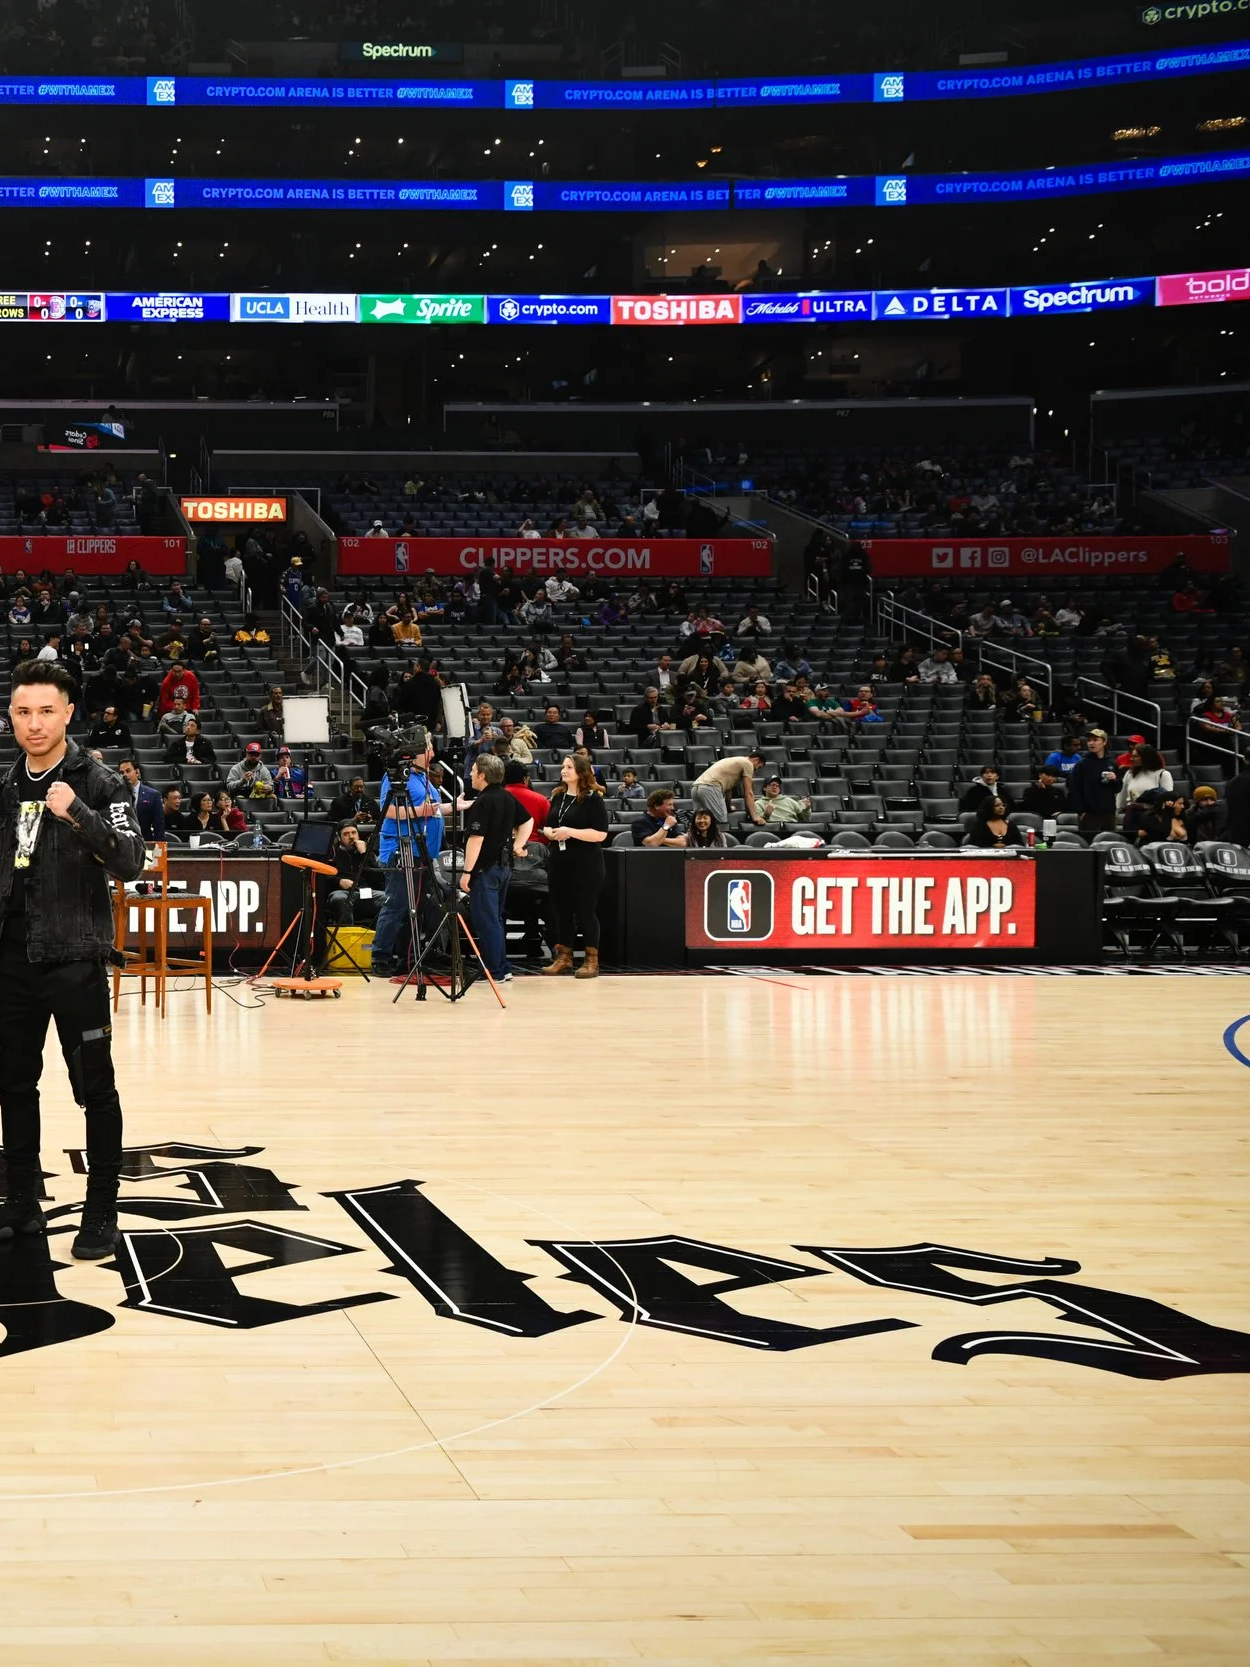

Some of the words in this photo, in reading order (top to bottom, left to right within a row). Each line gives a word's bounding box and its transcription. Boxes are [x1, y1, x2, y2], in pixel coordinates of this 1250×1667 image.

[363, 43, 433, 59] Spectrum
[938, 76, 1022, 90] CRYPTO.COM
[1027, 71, 1074, 84] ARENA
[1078, 68, 1092, 79] IS
[1097, 62, 1151, 77] BETTER
[154, 81, 175, 92] AM
[881, 77, 903, 88] AM
[38, 84, 115, 96] #WITHAMEX
[157, 90, 175, 101] EX
[207, 87, 285, 97] CRYPTO.COM
[288, 87, 329, 97] ARENA
[333, 88, 344, 97] IS
[348, 88, 395, 98] BETTER
[398, 88, 473, 99] #WITHAMEX
[512, 85, 533, 96] AM
[884, 86, 903, 97] EX
[515, 94, 533, 104] EX
[936, 180, 1022, 193] CRYPTO.COM
[1027, 176, 1075, 189] ARENA
[1080, 174, 1093, 184] IS
[1098, 168, 1154, 183] BETTER
[39, 186, 118, 198] #WITHAMEX
[132, 297, 203, 307] AMERICAN
[913, 295, 998, 313] DELTA
[1023, 286, 1133, 312] Spectrum
[41, 308, 49, 319] 0
[75, 308, 83, 319] 0
[142, 307, 204, 319] EXPRESS
[246, 302, 284, 315] UCLA
[295, 301, 350, 316] Health
[417, 298, 472, 319] Sprite
[522, 303, 598, 316] crypto.com
[618, 300, 734, 320] TOSHIBA
[746, 301, 800, 316] Michelob
[813, 300, 866, 313] ULTRA
[184, 502, 284, 519] TOSHIBA
[164, 540, 180, 548] 101
[342, 539, 359, 547] 102
[750, 541, 768, 549] 102
[1210, 536, 1229, 544] 103
[77, 539, 116, 554] CLIPPERS
[459, 547, 650, 570] CLIPPERS.COM
[1021, 547, 1148, 566] @LAClippers
[195, 880, 264, 932] APP.
[792, 877, 859, 935] GET
[867, 877, 934, 935] THE
[942, 877, 1016, 935] APP.
